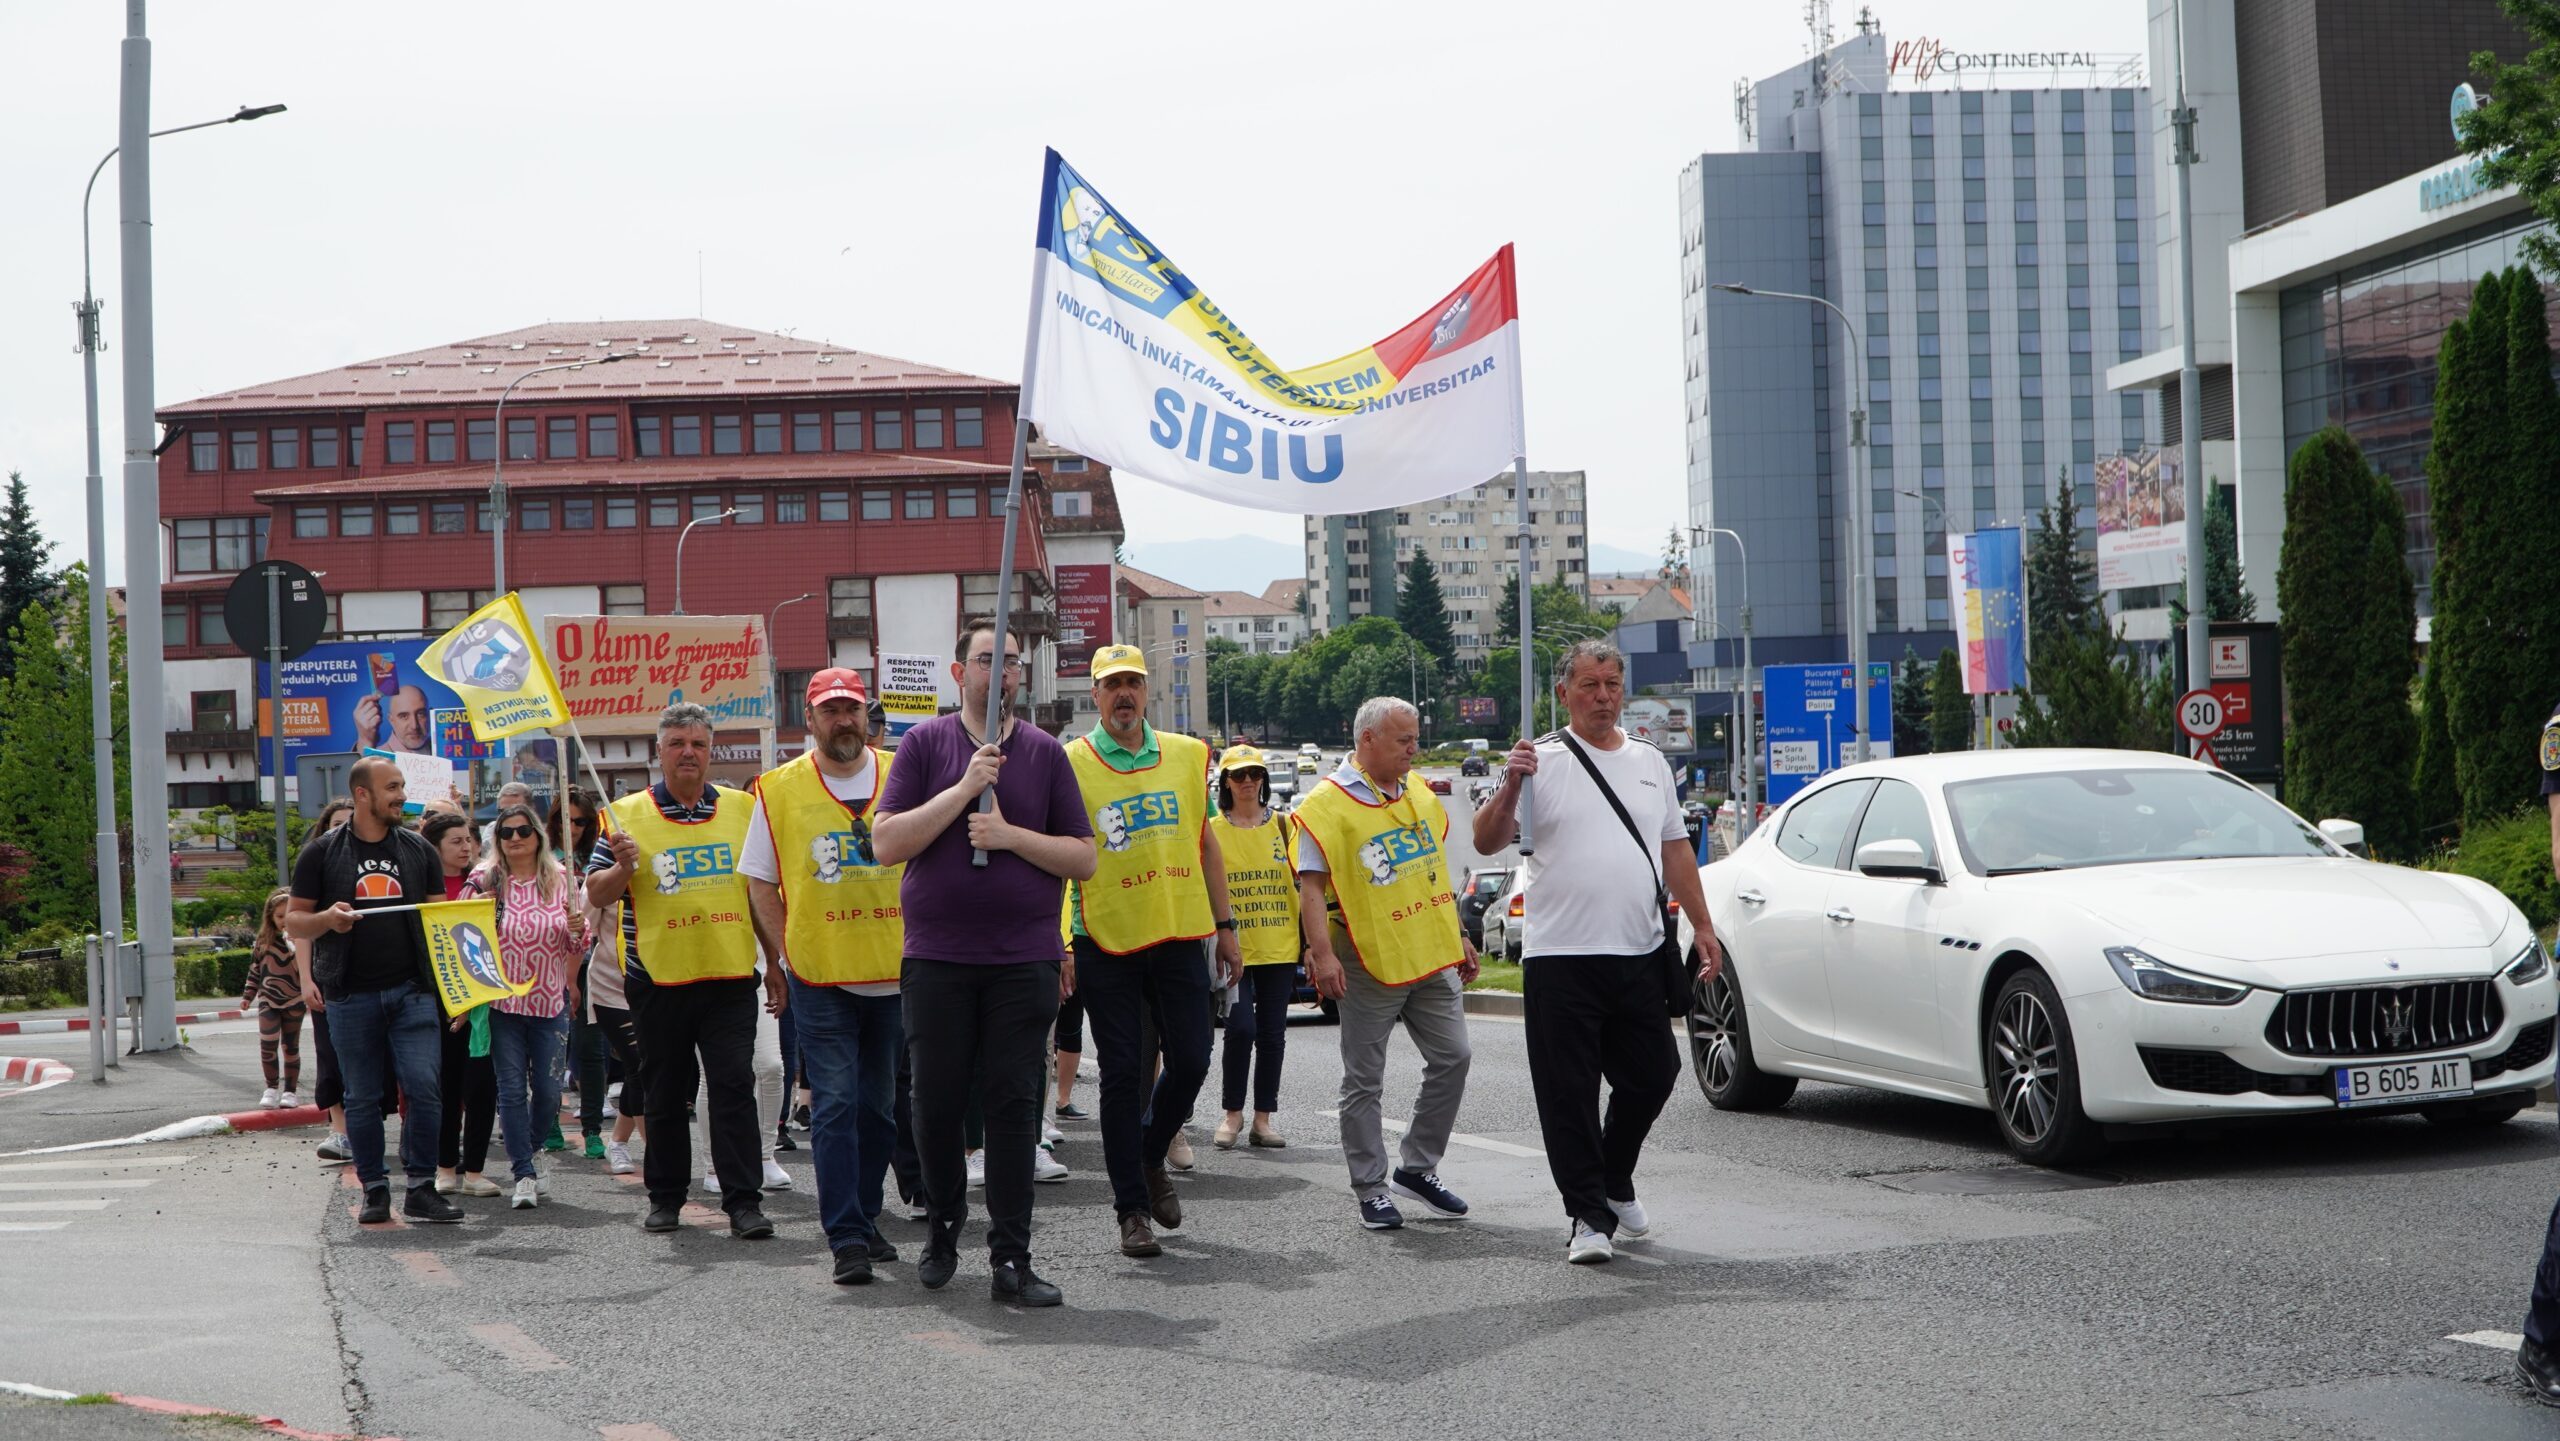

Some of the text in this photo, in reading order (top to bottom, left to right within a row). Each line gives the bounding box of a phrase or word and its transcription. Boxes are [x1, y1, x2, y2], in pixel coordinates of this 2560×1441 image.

[1937, 50, 2096, 72] CONTINENTAL
[1115, 272, 1160, 297] Haret
[1057, 291, 1496, 427] INDICATUL ÎNVĂȚĂMÂNTULUI UNIVERSITAR
[1301, 366, 1383, 397] NTEM
[1150, 387, 1344, 484] SIBIU
[556, 623, 582, 662] O
[589, 617, 670, 664] lume
[280, 660, 357, 671] UPERPUTEREA
[887, 659, 934, 668] RESPECTAȚI
[590, 664, 639, 687] care
[892, 668, 927, 676] DREPTUL
[316, 673, 357, 686] MyCLUB
[892, 676, 928, 684] COPIILOR
[896, 684, 937, 692] EDUCAȚIE!
[884, 694, 922, 703] INVESTIȚI
[282, 702, 319, 714] XTRA
[2190, 702, 2215, 726] 30
[283, 716, 320, 725] UTEREA
[436, 710, 469, 724] GRĂD
[1770, 726, 1795, 735] Agnita
[2236, 730, 2253, 740] km
[1785, 754, 1806, 762] Spital
[1120, 794, 1179, 828] FSE
[675, 847, 732, 874] FSE
[844, 868, 871, 880] Spiru
[1399, 864, 1421, 876] Spiru
[682, 877, 734, 890] Spiru Haret
[1121, 866, 1190, 888] S.I.P. SIBIU
[1230, 886, 1288, 898] NDICATELOR
[826, 907, 902, 922] S.I.P. SIBI
[1244, 902, 1289, 916] EDUCAȚIE
[1392, 902, 1427, 922] S.I.P.
[667, 915, 706, 930] S.I.P.
[1236, 918, 1258, 930] PIRU
[2353, 1063, 2459, 1096] B 605 AIT
[2339, 1088, 2349, 1096] RO
